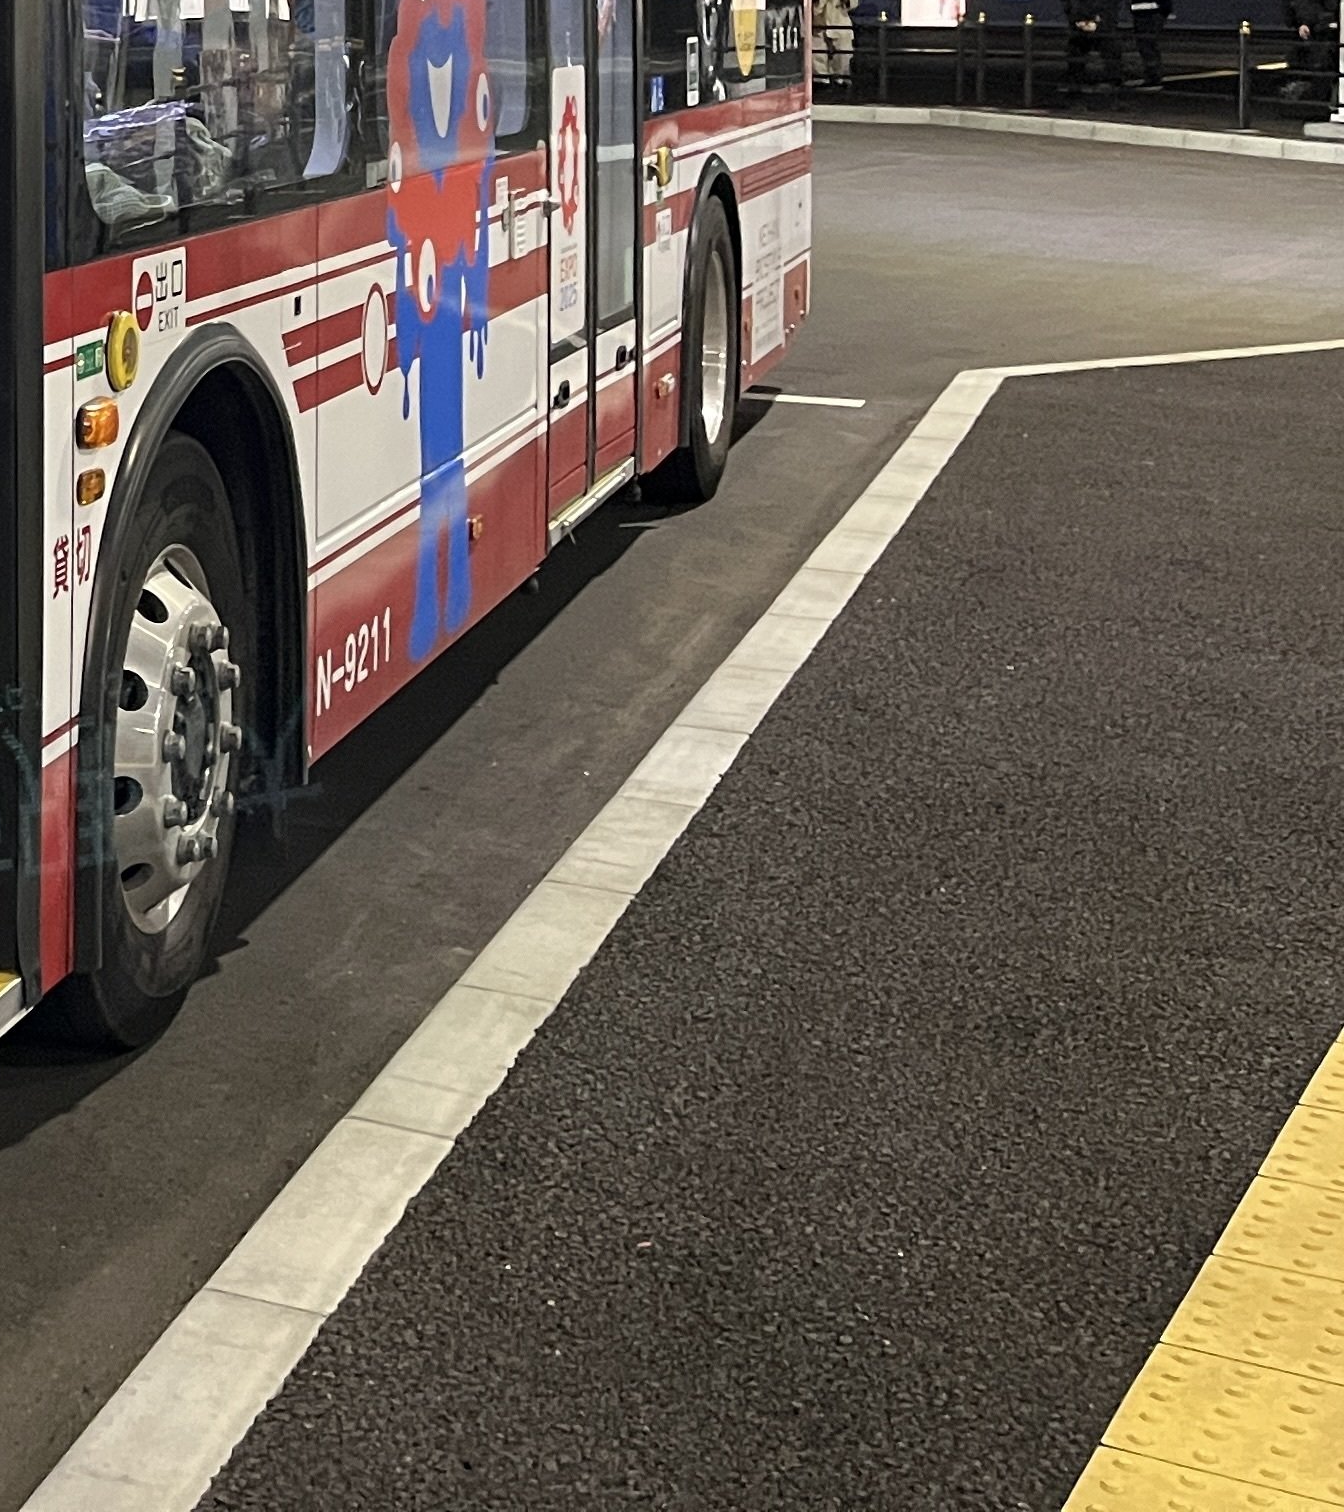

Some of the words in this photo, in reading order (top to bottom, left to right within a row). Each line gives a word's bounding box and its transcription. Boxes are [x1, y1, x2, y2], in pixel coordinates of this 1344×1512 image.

[155, 259, 183, 302] 出口
[158, 306, 179, 332] EXIT
[316, 606, 392, 717] N-9211
